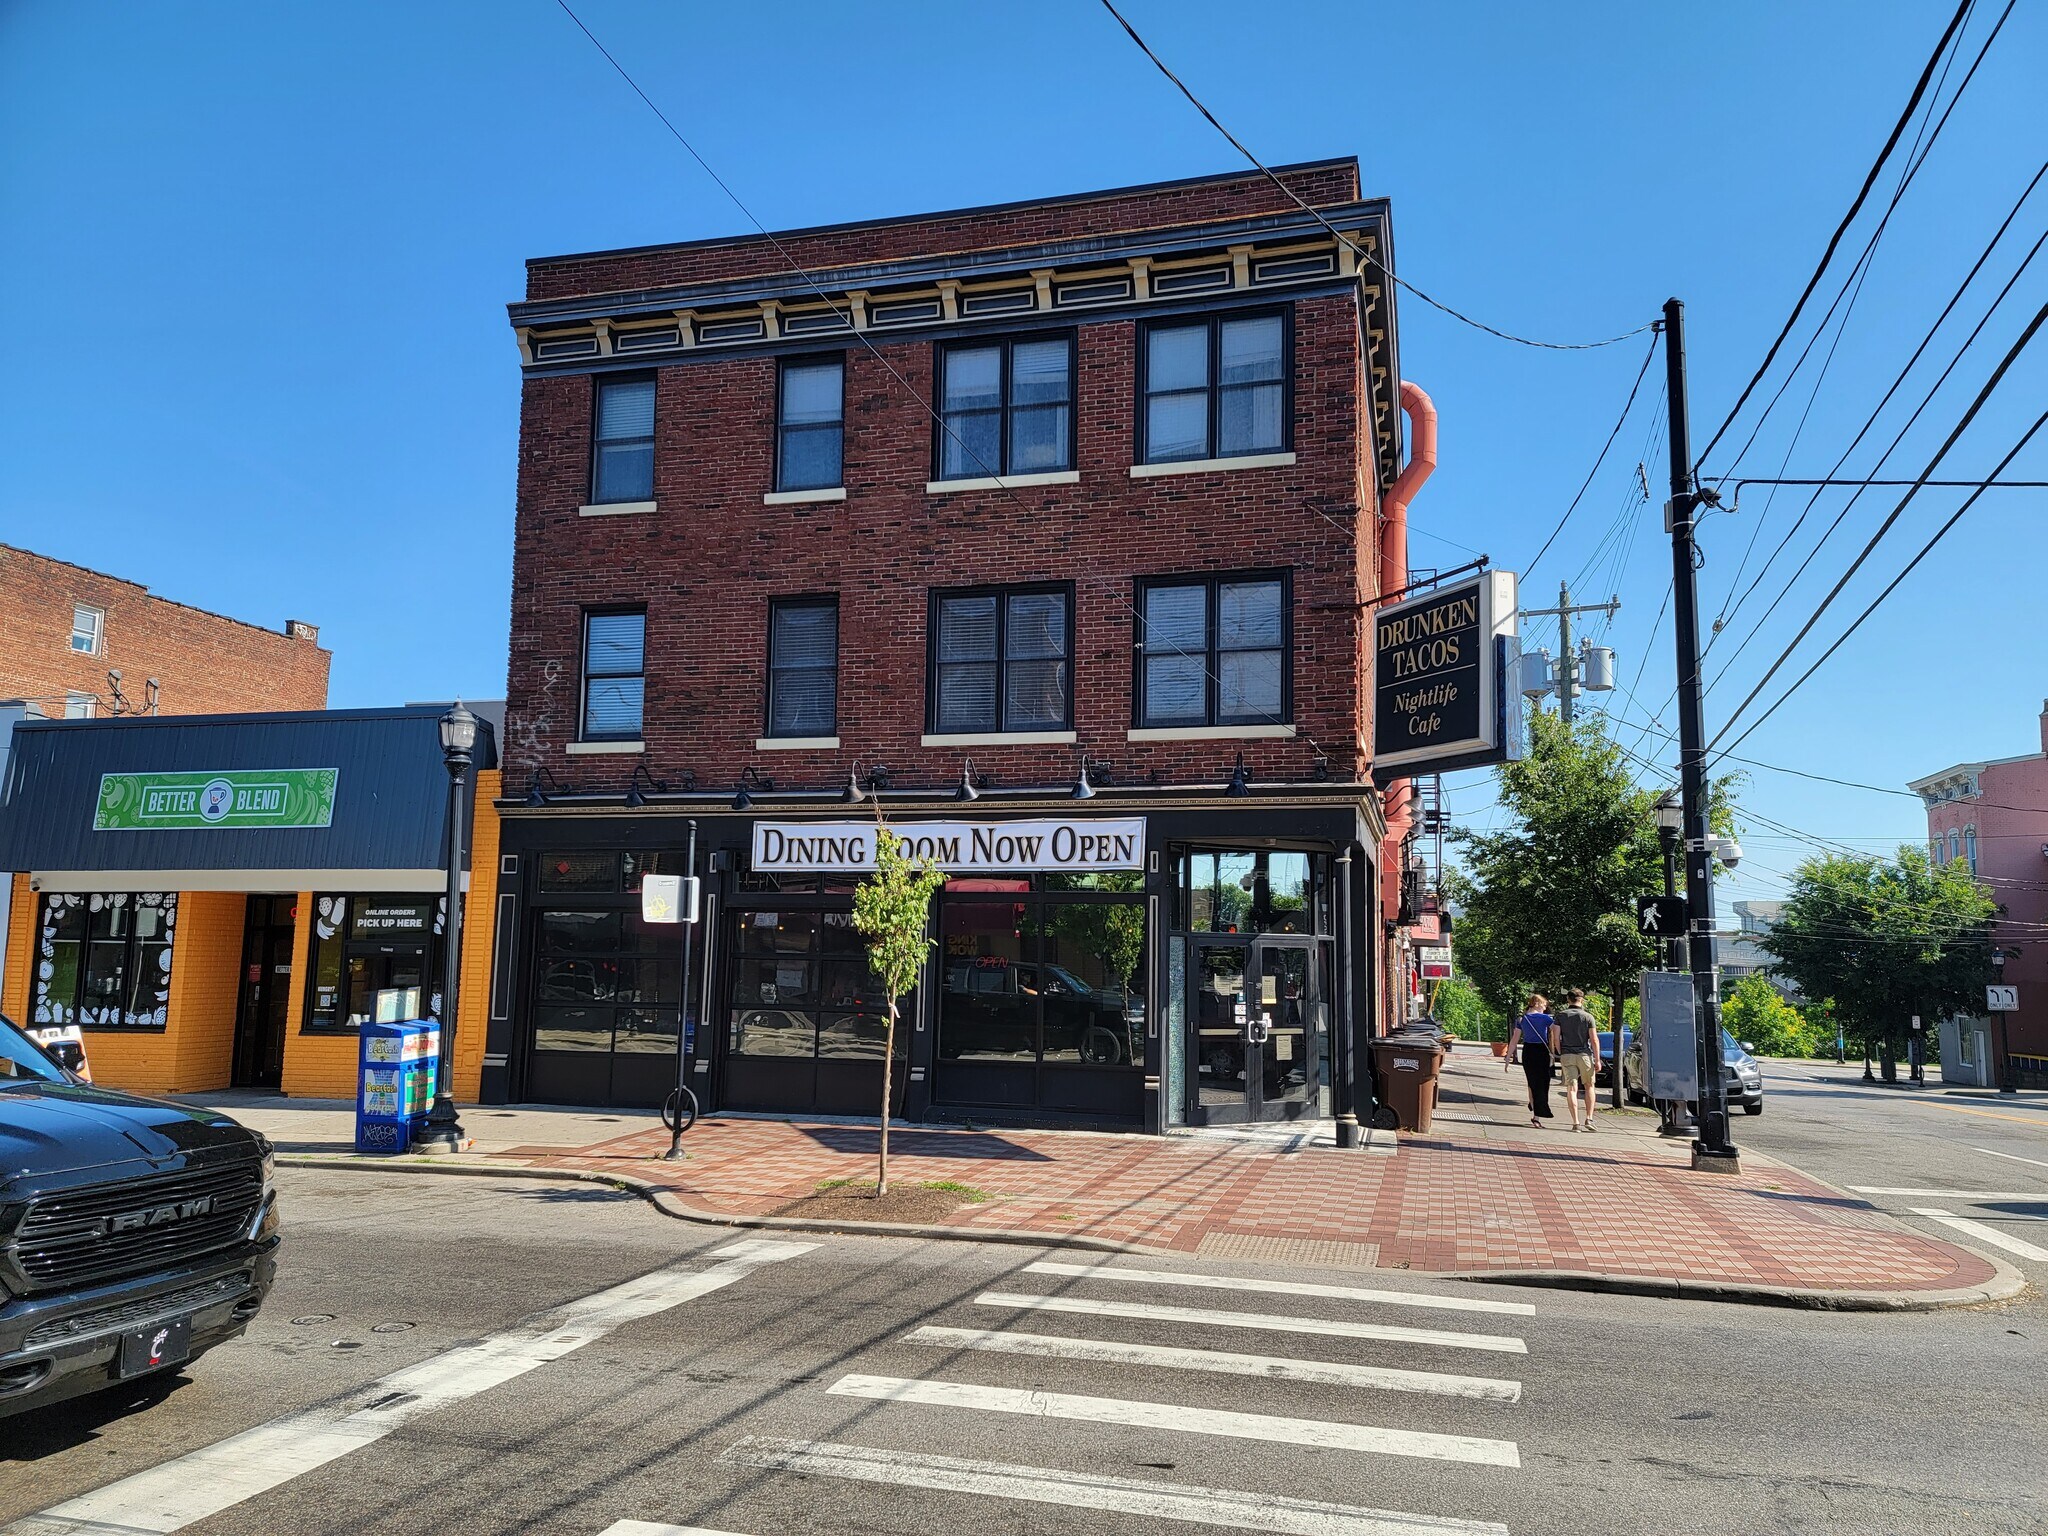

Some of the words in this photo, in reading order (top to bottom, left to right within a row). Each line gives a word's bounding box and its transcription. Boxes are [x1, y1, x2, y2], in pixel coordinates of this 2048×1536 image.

[1378, 596, 1477, 651] DRUNKEN
[1392, 635, 1460, 678] TACOS
[1393, 682, 1458, 714] Nightlife
[1408, 712, 1441, 736] Cafe
[147, 791, 196, 812] BETTER
[236, 789, 280, 811] BLEND
[357, 919, 380, 928] PICK
[381, 919, 395, 928] UP
[396, 919, 422, 928] HERE
[975, 956, 1009, 969] OPEN
[111, 1196, 210, 1233] RAM
